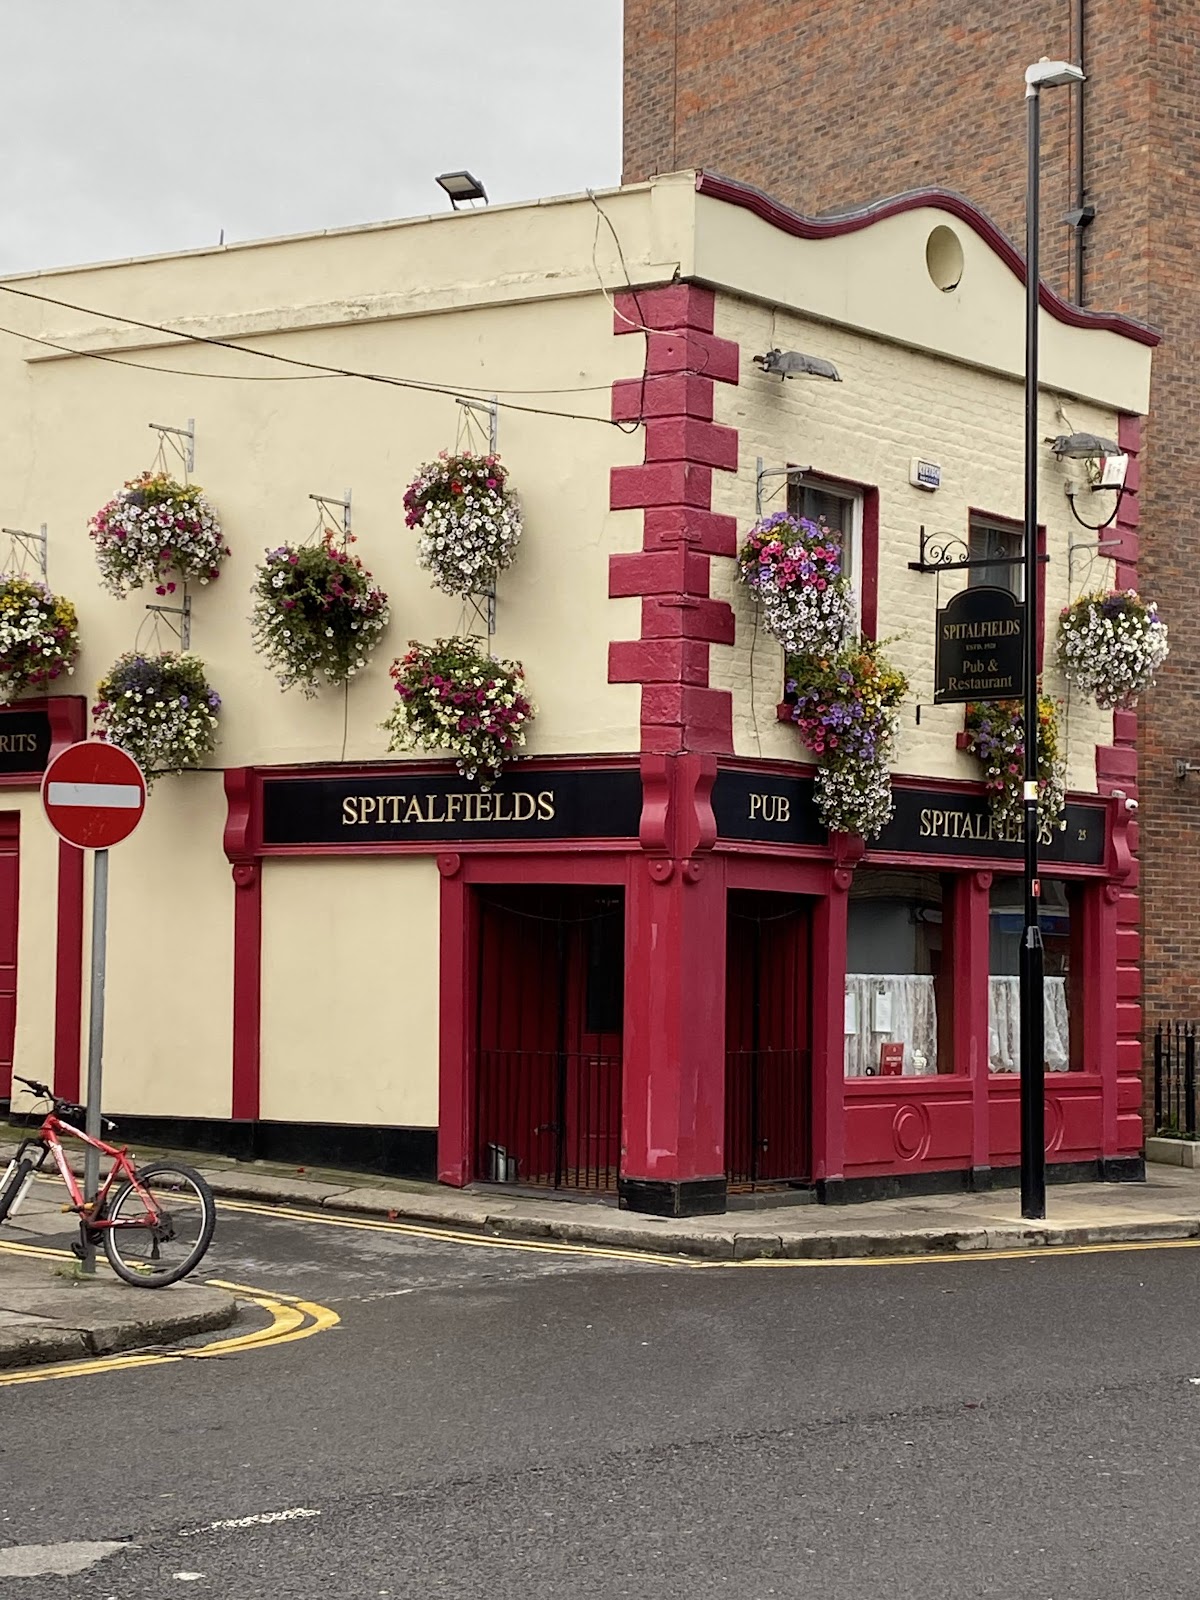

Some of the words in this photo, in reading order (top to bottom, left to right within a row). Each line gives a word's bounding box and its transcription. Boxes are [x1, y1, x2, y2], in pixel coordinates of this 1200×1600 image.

[943, 619, 1020, 640] SPITALFIELDS
[963, 660, 985, 674] Pub
[987, 659, 999, 672] &
[949, 676, 1012, 690] Restaurant
[0, 734, 37, 752] RITS
[342, 790, 555, 825] SPITALFIELDS
[748, 793, 790, 822] PUB
